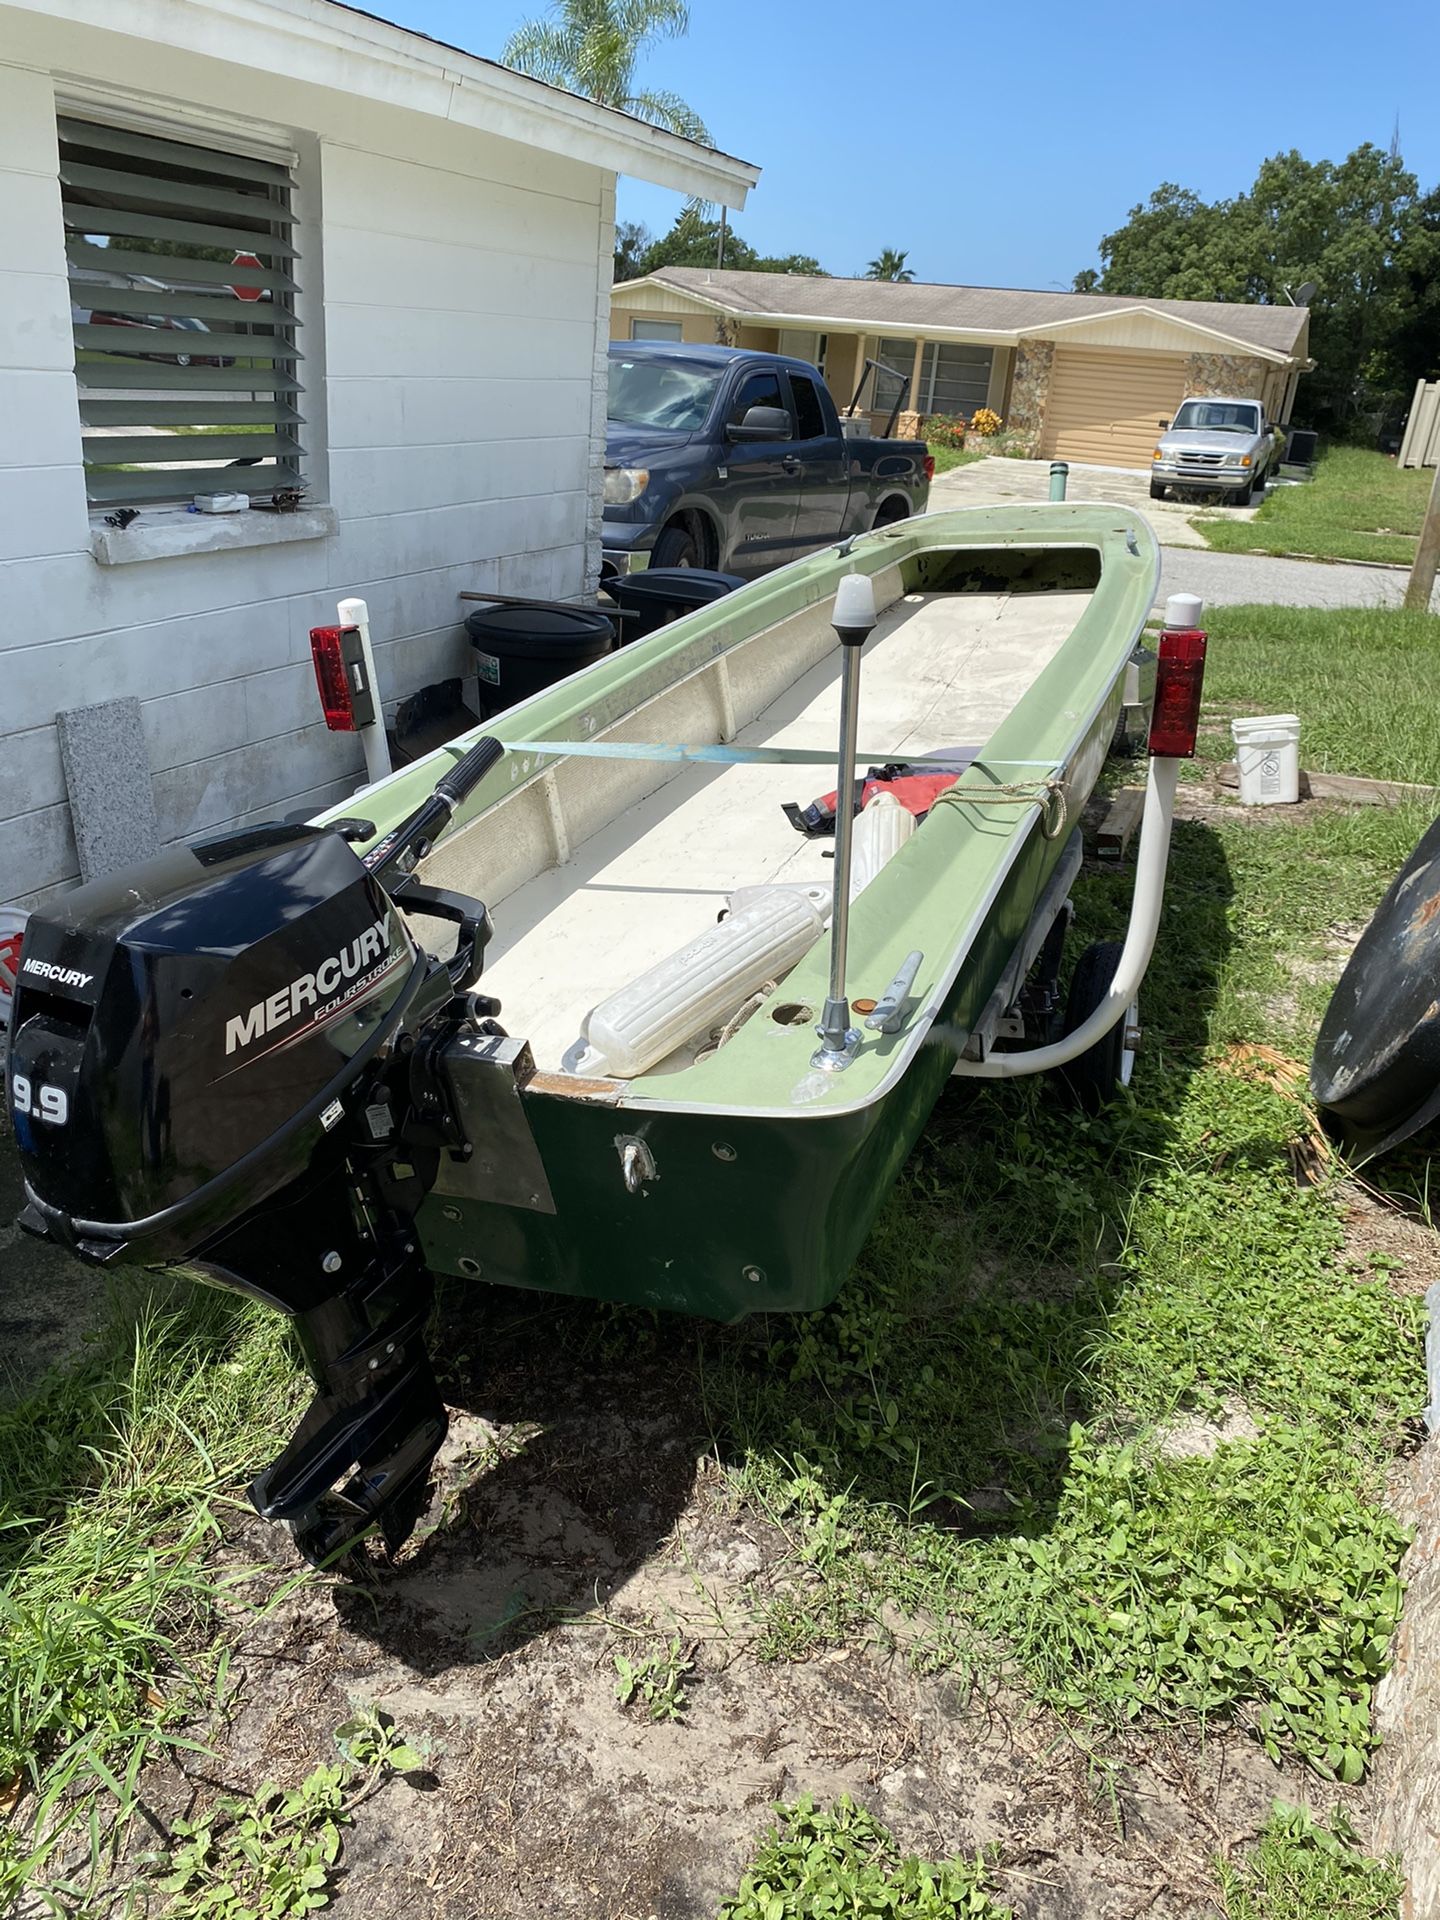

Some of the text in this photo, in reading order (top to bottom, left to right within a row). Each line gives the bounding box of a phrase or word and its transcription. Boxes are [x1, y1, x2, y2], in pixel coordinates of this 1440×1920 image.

[23, 958, 93, 988] MERCURY
[226, 911, 391, 1055] MERCURY
[313, 946, 402, 1021] FOURSTROKE
[13, 1074, 67, 1124] 9.9
